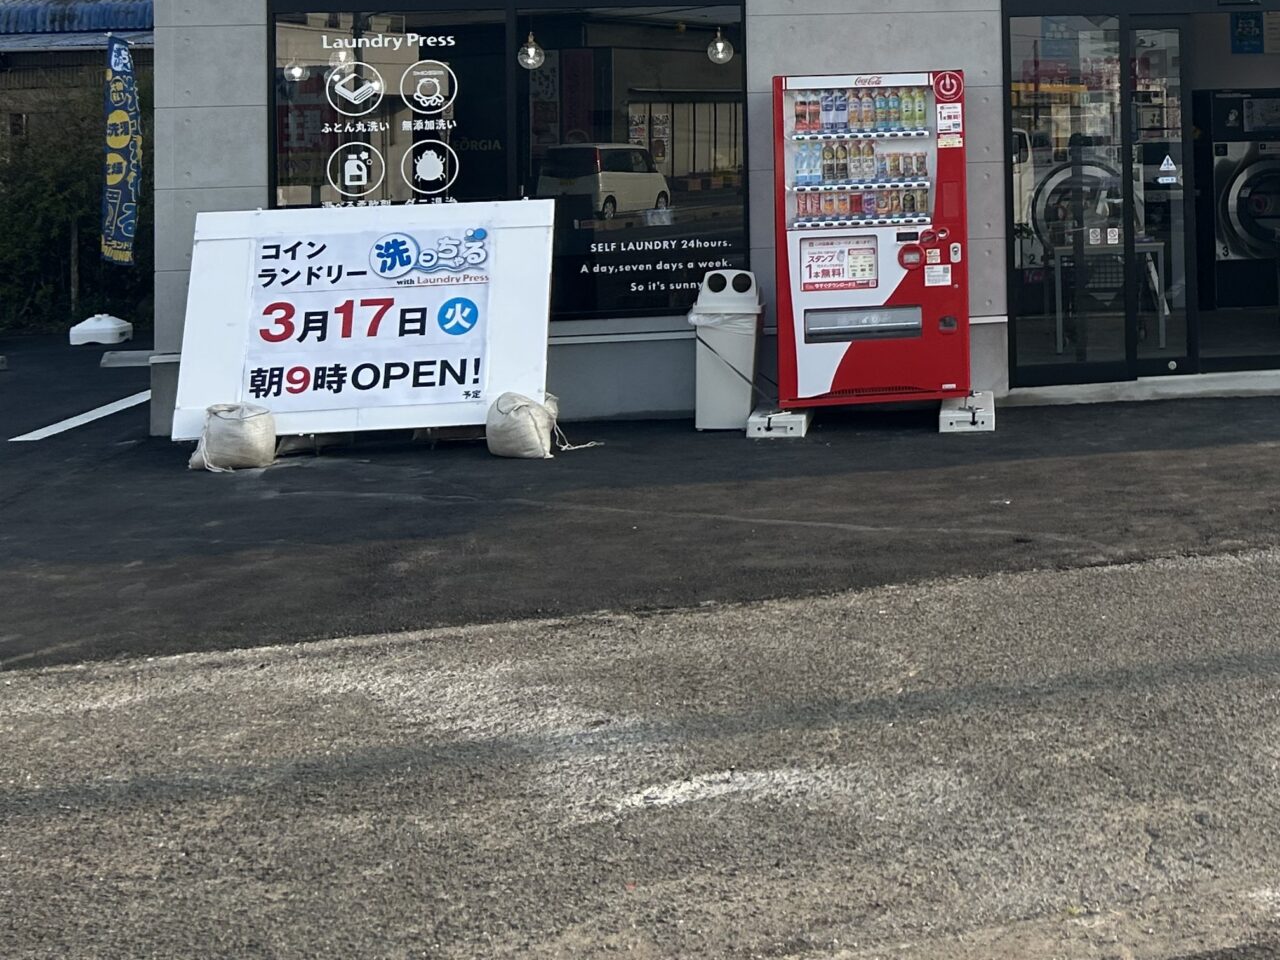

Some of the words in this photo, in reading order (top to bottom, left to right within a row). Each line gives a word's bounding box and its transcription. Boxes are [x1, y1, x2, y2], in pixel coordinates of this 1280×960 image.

[321, 33, 402, 51] Laundry
[406, 33, 456, 47] Press
[320, 121, 390, 133] ふとん丸洗い
[401, 119, 457, 131] 無添加洗い
[261, 241, 327, 261] コイン
[590, 242, 617, 252] SELF
[620, 240, 677, 252] LAUNDRY
[1222, 246, 1229, 257] 3
[1029, 254, 1036, 264] 2
[580, 264, 589, 273] A
[655, 260, 684, 272] days
[698, 259, 733, 269] week.
[257, 263, 368, 288] ランドリー
[396, 278, 415, 286] with
[417, 275, 460, 285] Laundry
[463, 273, 489, 283] Press
[630, 282, 644, 292] So
[648, 281, 665, 291] it's
[259, 297, 428, 343] 3月17日
[444, 303, 475, 330] 火
[462, 390, 481, 400] 予定
